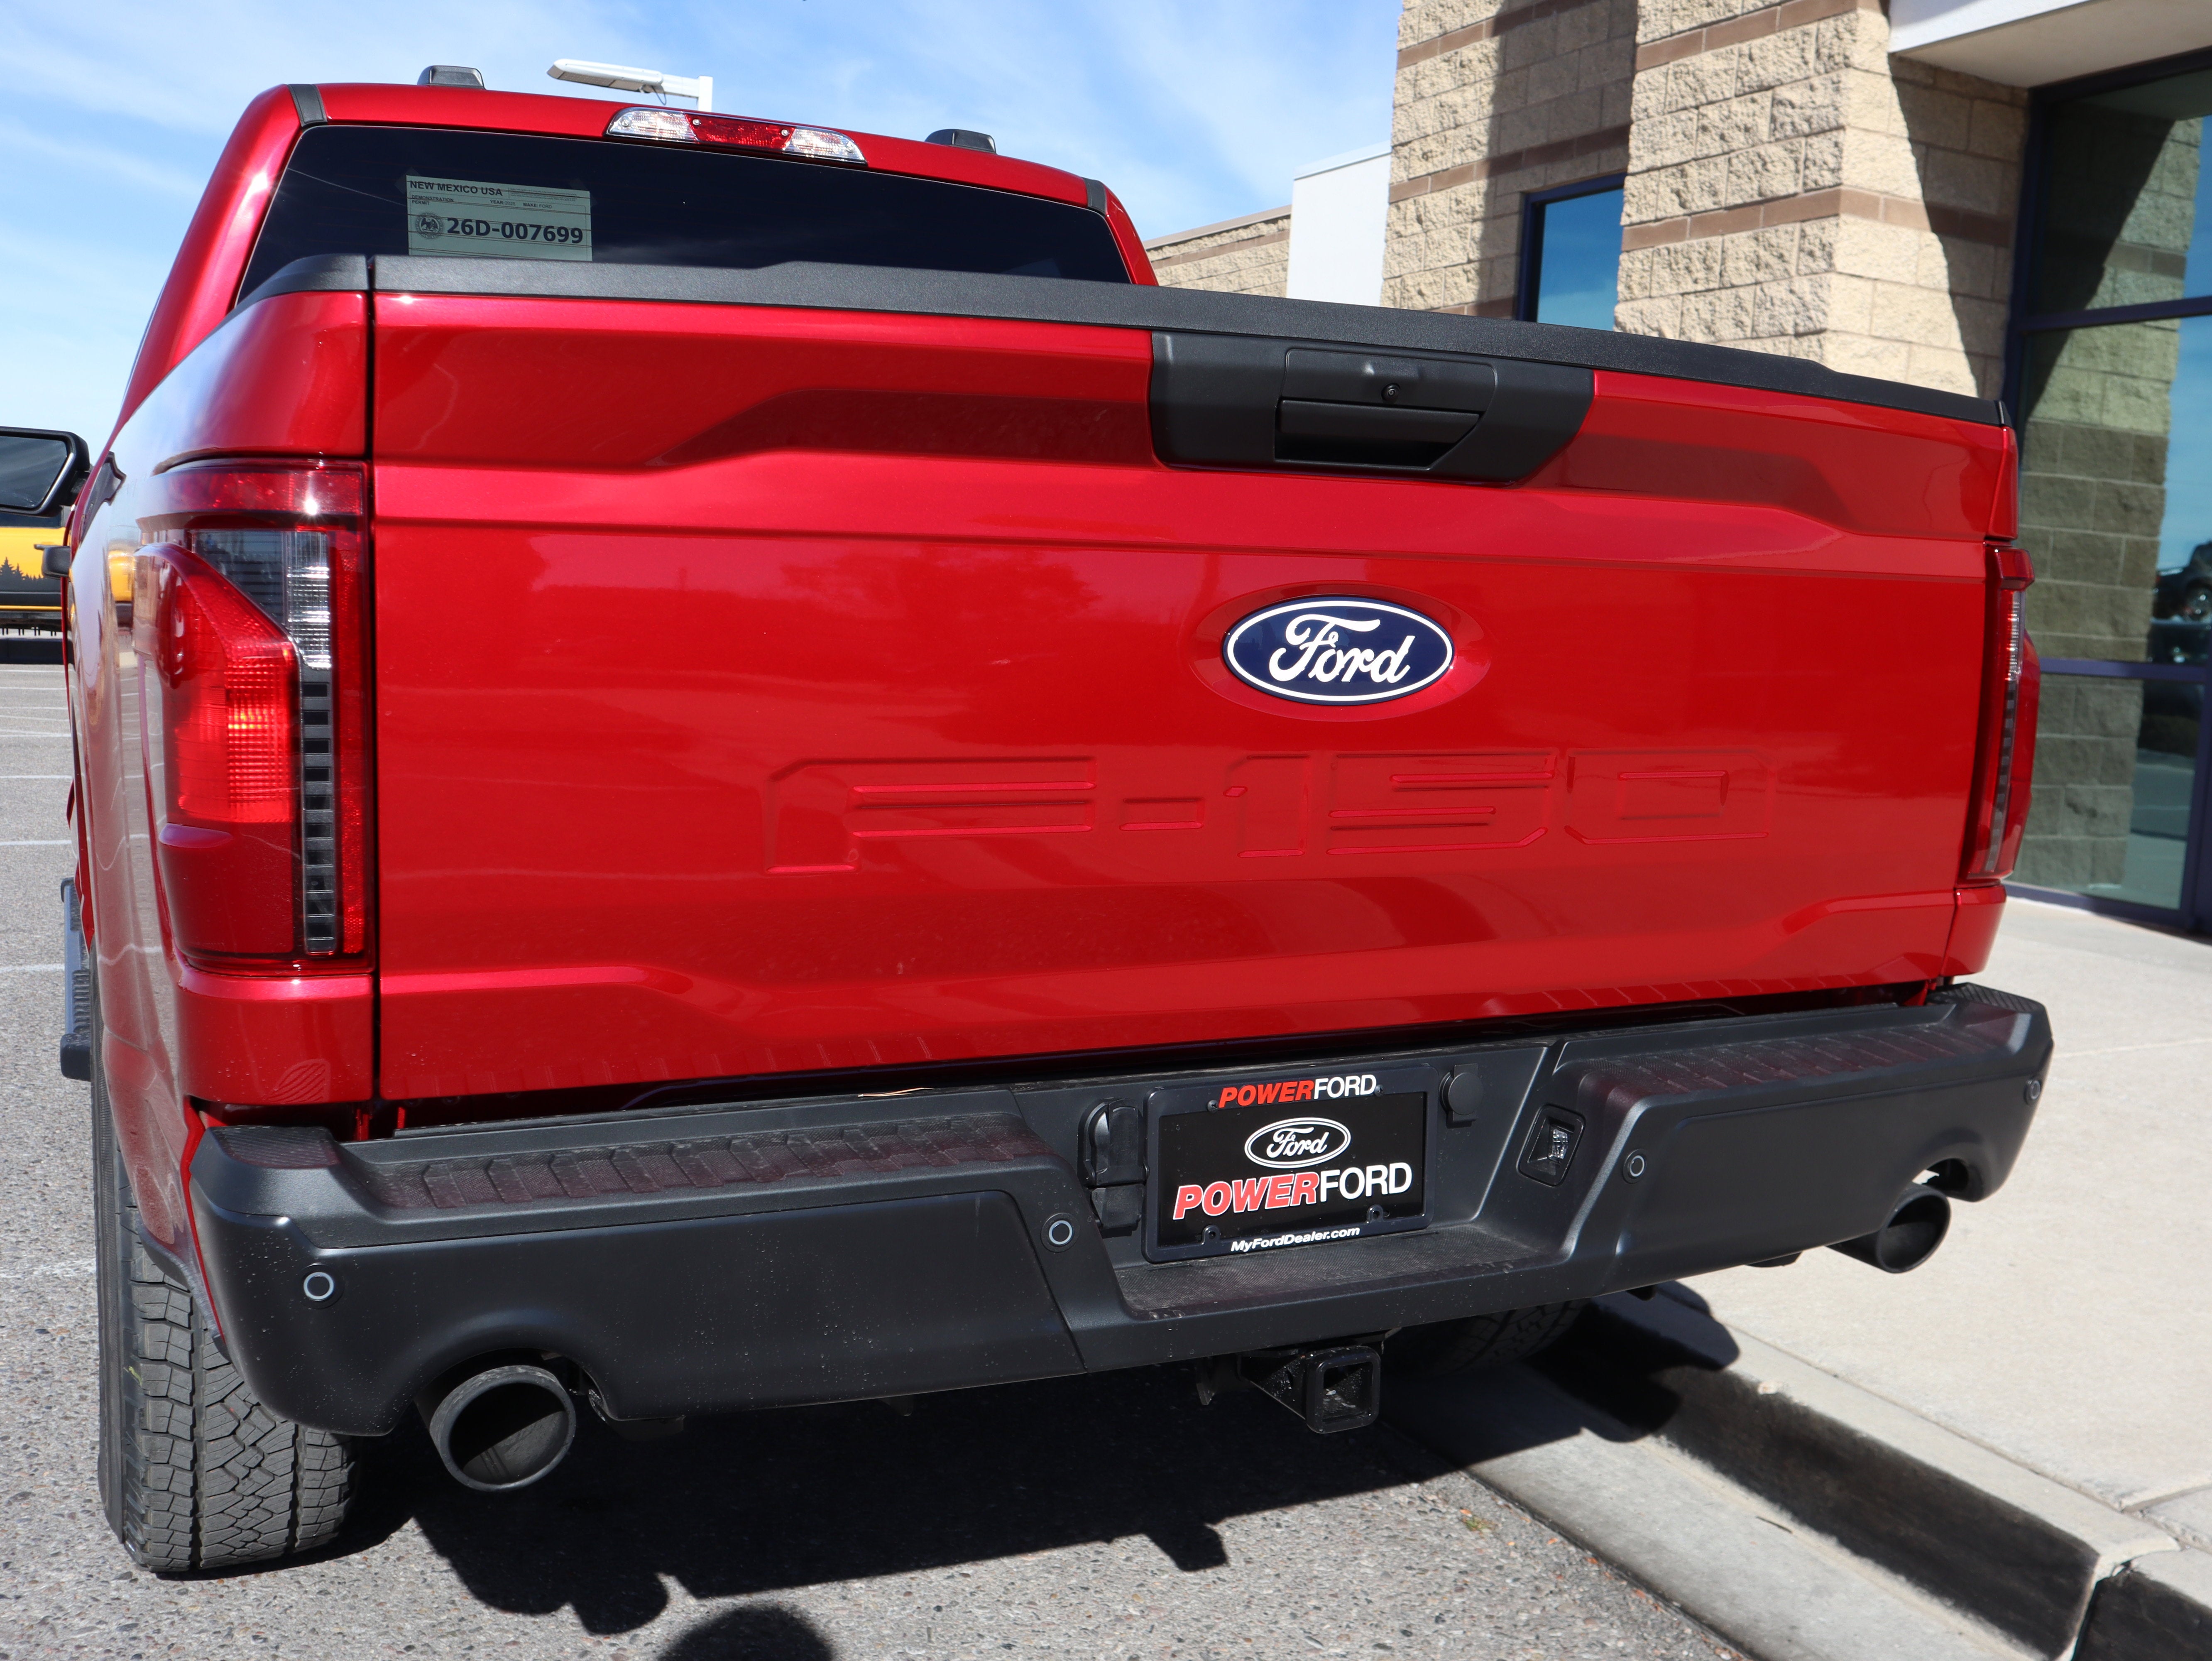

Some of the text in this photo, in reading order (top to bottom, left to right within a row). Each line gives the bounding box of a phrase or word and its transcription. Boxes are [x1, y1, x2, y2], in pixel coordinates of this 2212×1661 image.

[410, 181, 434, 190] NEW
[437, 183, 478, 194] MEXICO
[481, 188, 503, 196] USA
[447, 217, 583, 244] 26D-007699
[1269, 613, 1415, 683] Ford
[765, 746, 1773, 875] F-150
[1219, 1074, 1377, 1108] POWERFORD
[1266, 1127, 1329, 1158] Ford
[1172, 1162, 1412, 1220] POWERFORD
[1231, 1227, 1360, 1252] MyFordDealer.com
